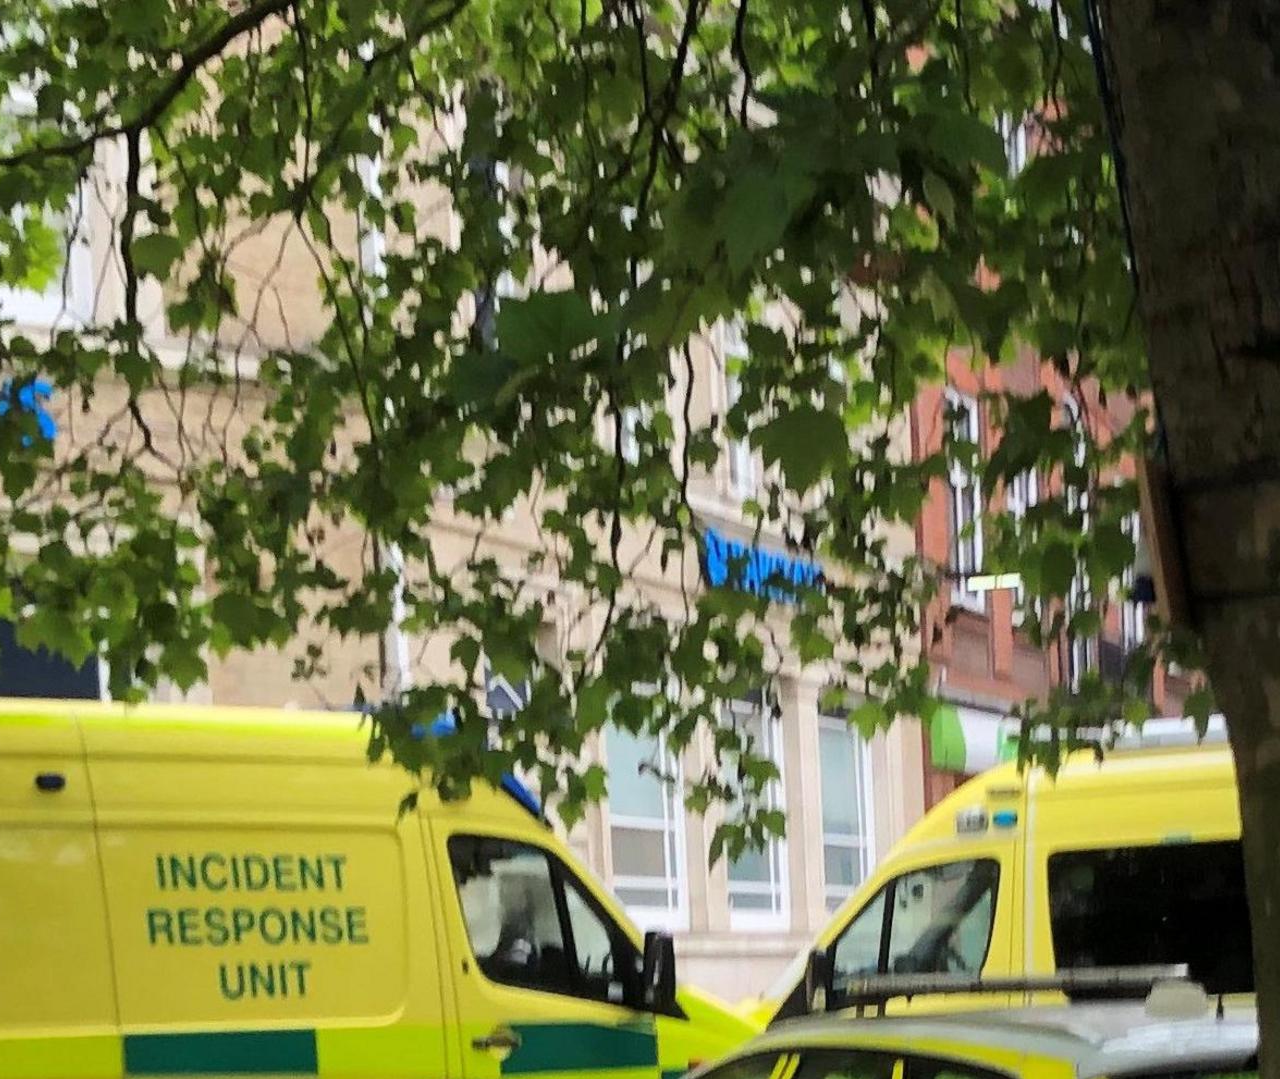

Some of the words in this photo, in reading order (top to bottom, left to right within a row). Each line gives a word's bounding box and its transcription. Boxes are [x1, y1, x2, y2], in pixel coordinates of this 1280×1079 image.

[156, 853, 346, 891] INCIDENT
[147, 907, 368, 945] RESPONSE
[220, 960, 311, 1000] UNIT
